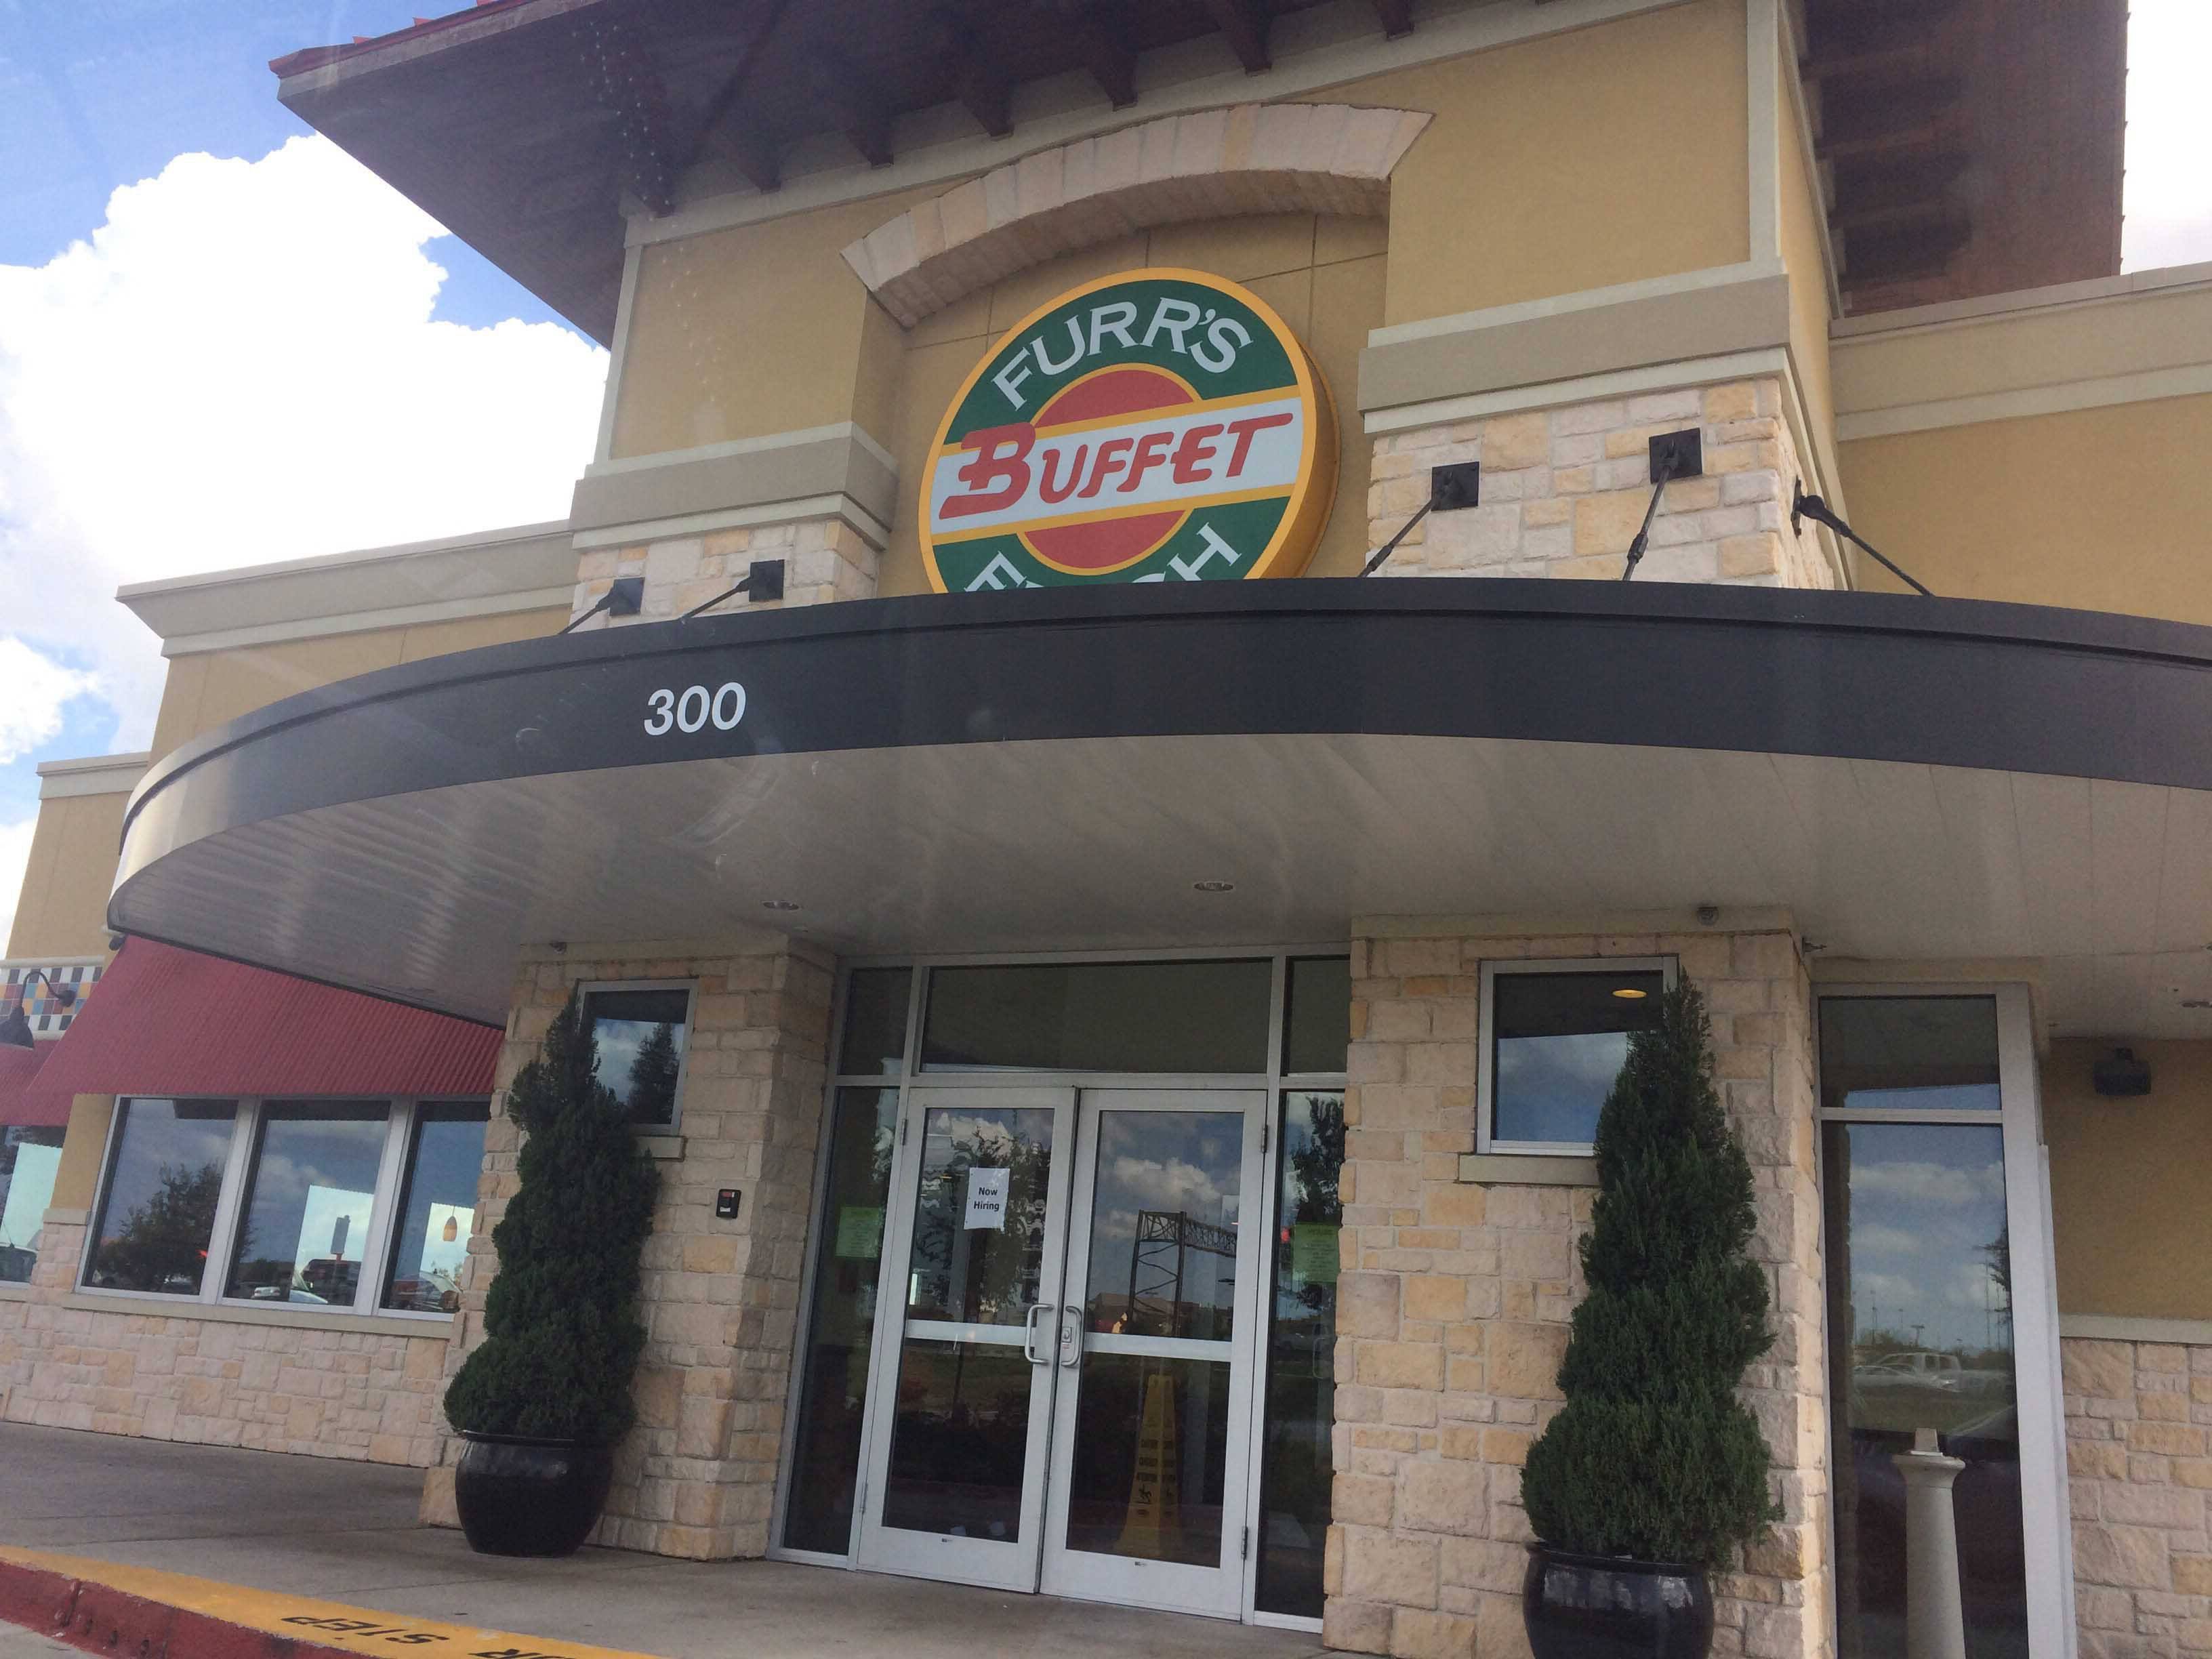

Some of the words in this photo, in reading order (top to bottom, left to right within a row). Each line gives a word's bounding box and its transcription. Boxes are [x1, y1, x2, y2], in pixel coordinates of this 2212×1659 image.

[991, 297, 1252, 411] FURR'S
[939, 413, 1293, 520] BUFFET
[644, 682, 746, 735] 300
[973, 1201, 1000, 1212] Hiring
[979, 1187, 998, 1195] Now
